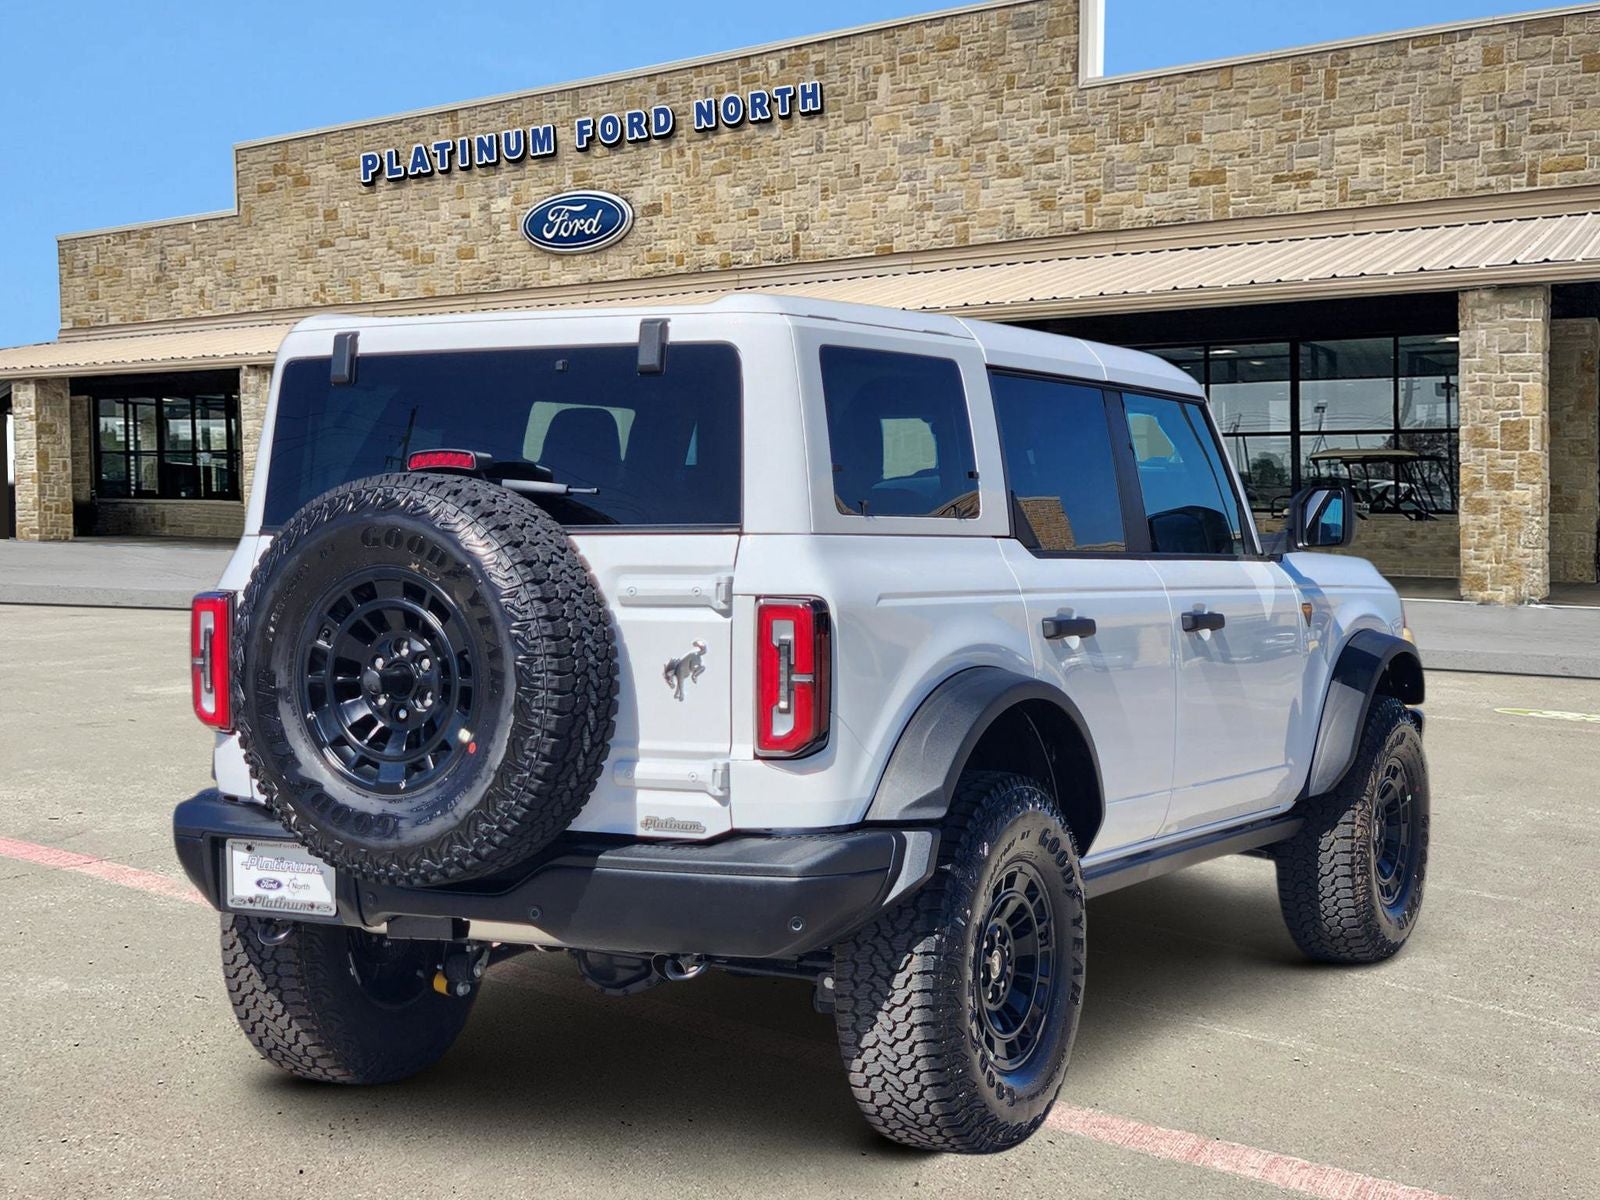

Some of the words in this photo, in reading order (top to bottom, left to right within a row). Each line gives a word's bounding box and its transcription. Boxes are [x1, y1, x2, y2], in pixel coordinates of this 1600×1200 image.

[360, 124, 556, 185] PLATINUM
[575, 105, 675, 150] FORD
[694, 81, 823, 130] NORTH
[542, 203, 602, 240] Ford
[641, 816, 706, 833] Platinum
[241, 856, 324, 875] Platinum
[259, 880, 278, 889] Ford
[291, 882, 310, 891] North
[252, 894, 314, 911] Platinum
